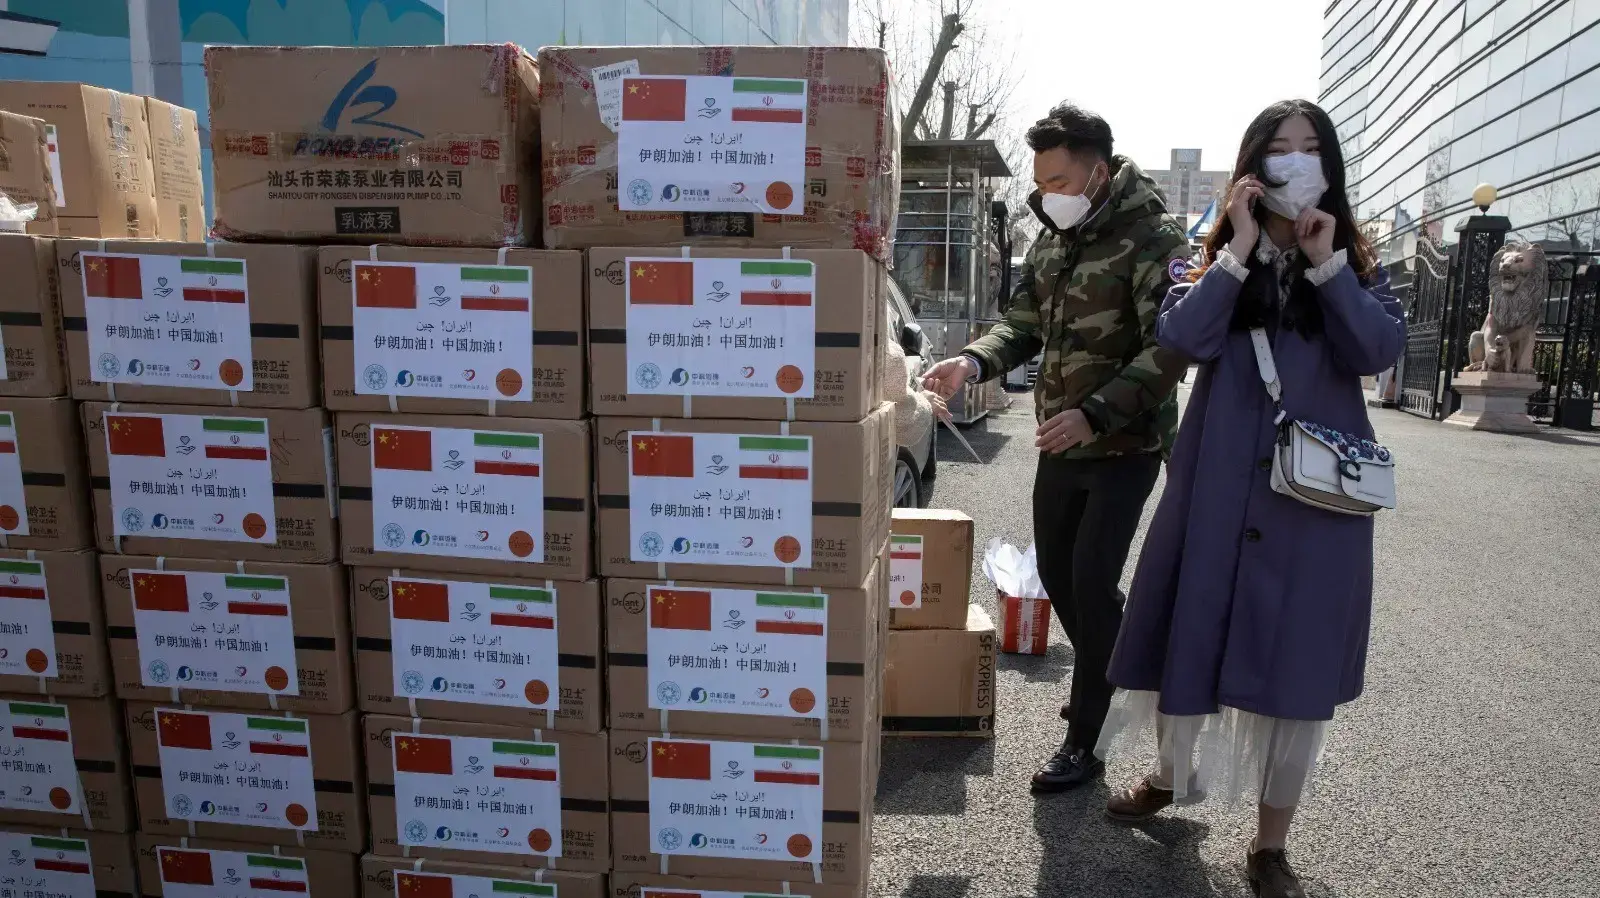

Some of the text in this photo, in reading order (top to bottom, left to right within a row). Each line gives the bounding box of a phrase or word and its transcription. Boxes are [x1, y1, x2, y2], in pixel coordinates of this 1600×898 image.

[267, 169, 463, 188] 汕头市荣森泵业有限公司
[810, 178, 827, 198] 司
[268, 191, 304, 201] SHANTOU
[320, 191, 357, 201] RONGSEN
[358, 191, 406, 201] DISPENSING
[406, 191, 430, 201] PUMP
[340, 211, 393, 230] 乳液泵
[594, 267, 623, 277] Dr.ant
[341, 429, 367, 439] Dr.ant
[612, 597, 640, 607] Dr.ant
[977, 634, 993, 710] SF EXPRESS
[559, 687, 583, 699] 卫士
